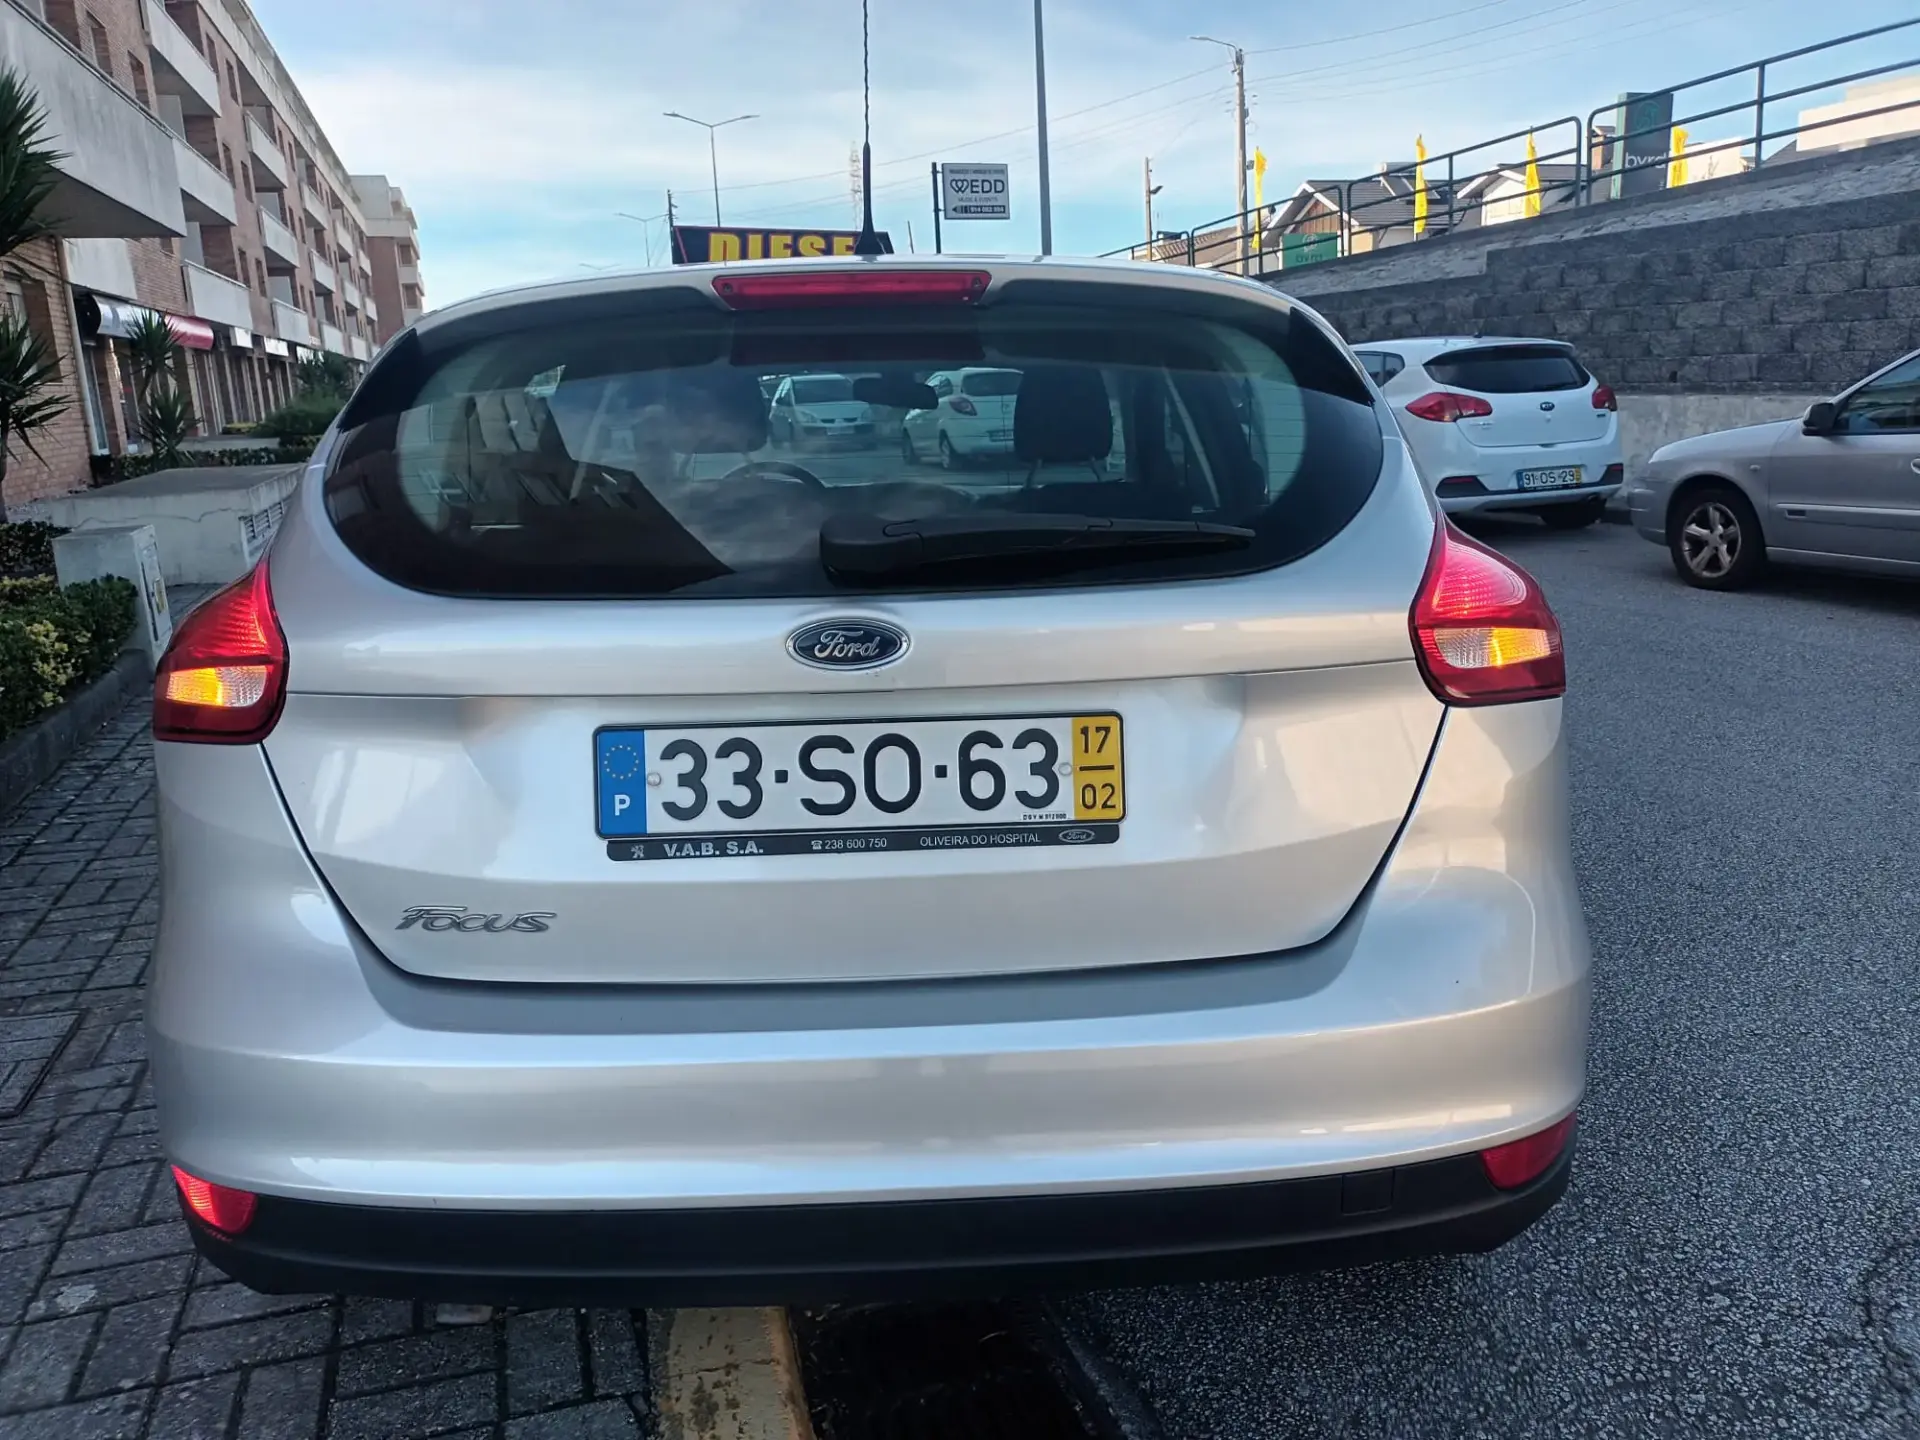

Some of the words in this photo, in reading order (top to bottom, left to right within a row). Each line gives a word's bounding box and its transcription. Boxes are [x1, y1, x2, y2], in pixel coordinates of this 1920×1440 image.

[708, 231, 855, 262] DIESE
[814, 630, 880, 658] Ford
[1079, 725, 1111, 754] 17
[614, 794, 631, 816] P
[1081, 782, 1116, 810] 02
[824, 839, 844, 850] 238
[846, 838, 866, 849] 600
[868, 837, 887, 848] 750
[919, 835, 969, 847] OLIVEIRA
[971, 834, 987, 845] DO
[989, 833, 1041, 844] HOSPITAL
[1066, 831, 1087, 840] Ford
[663, 841, 720, 857] V.A.B.
[726, 840, 763, 855] S.A.
